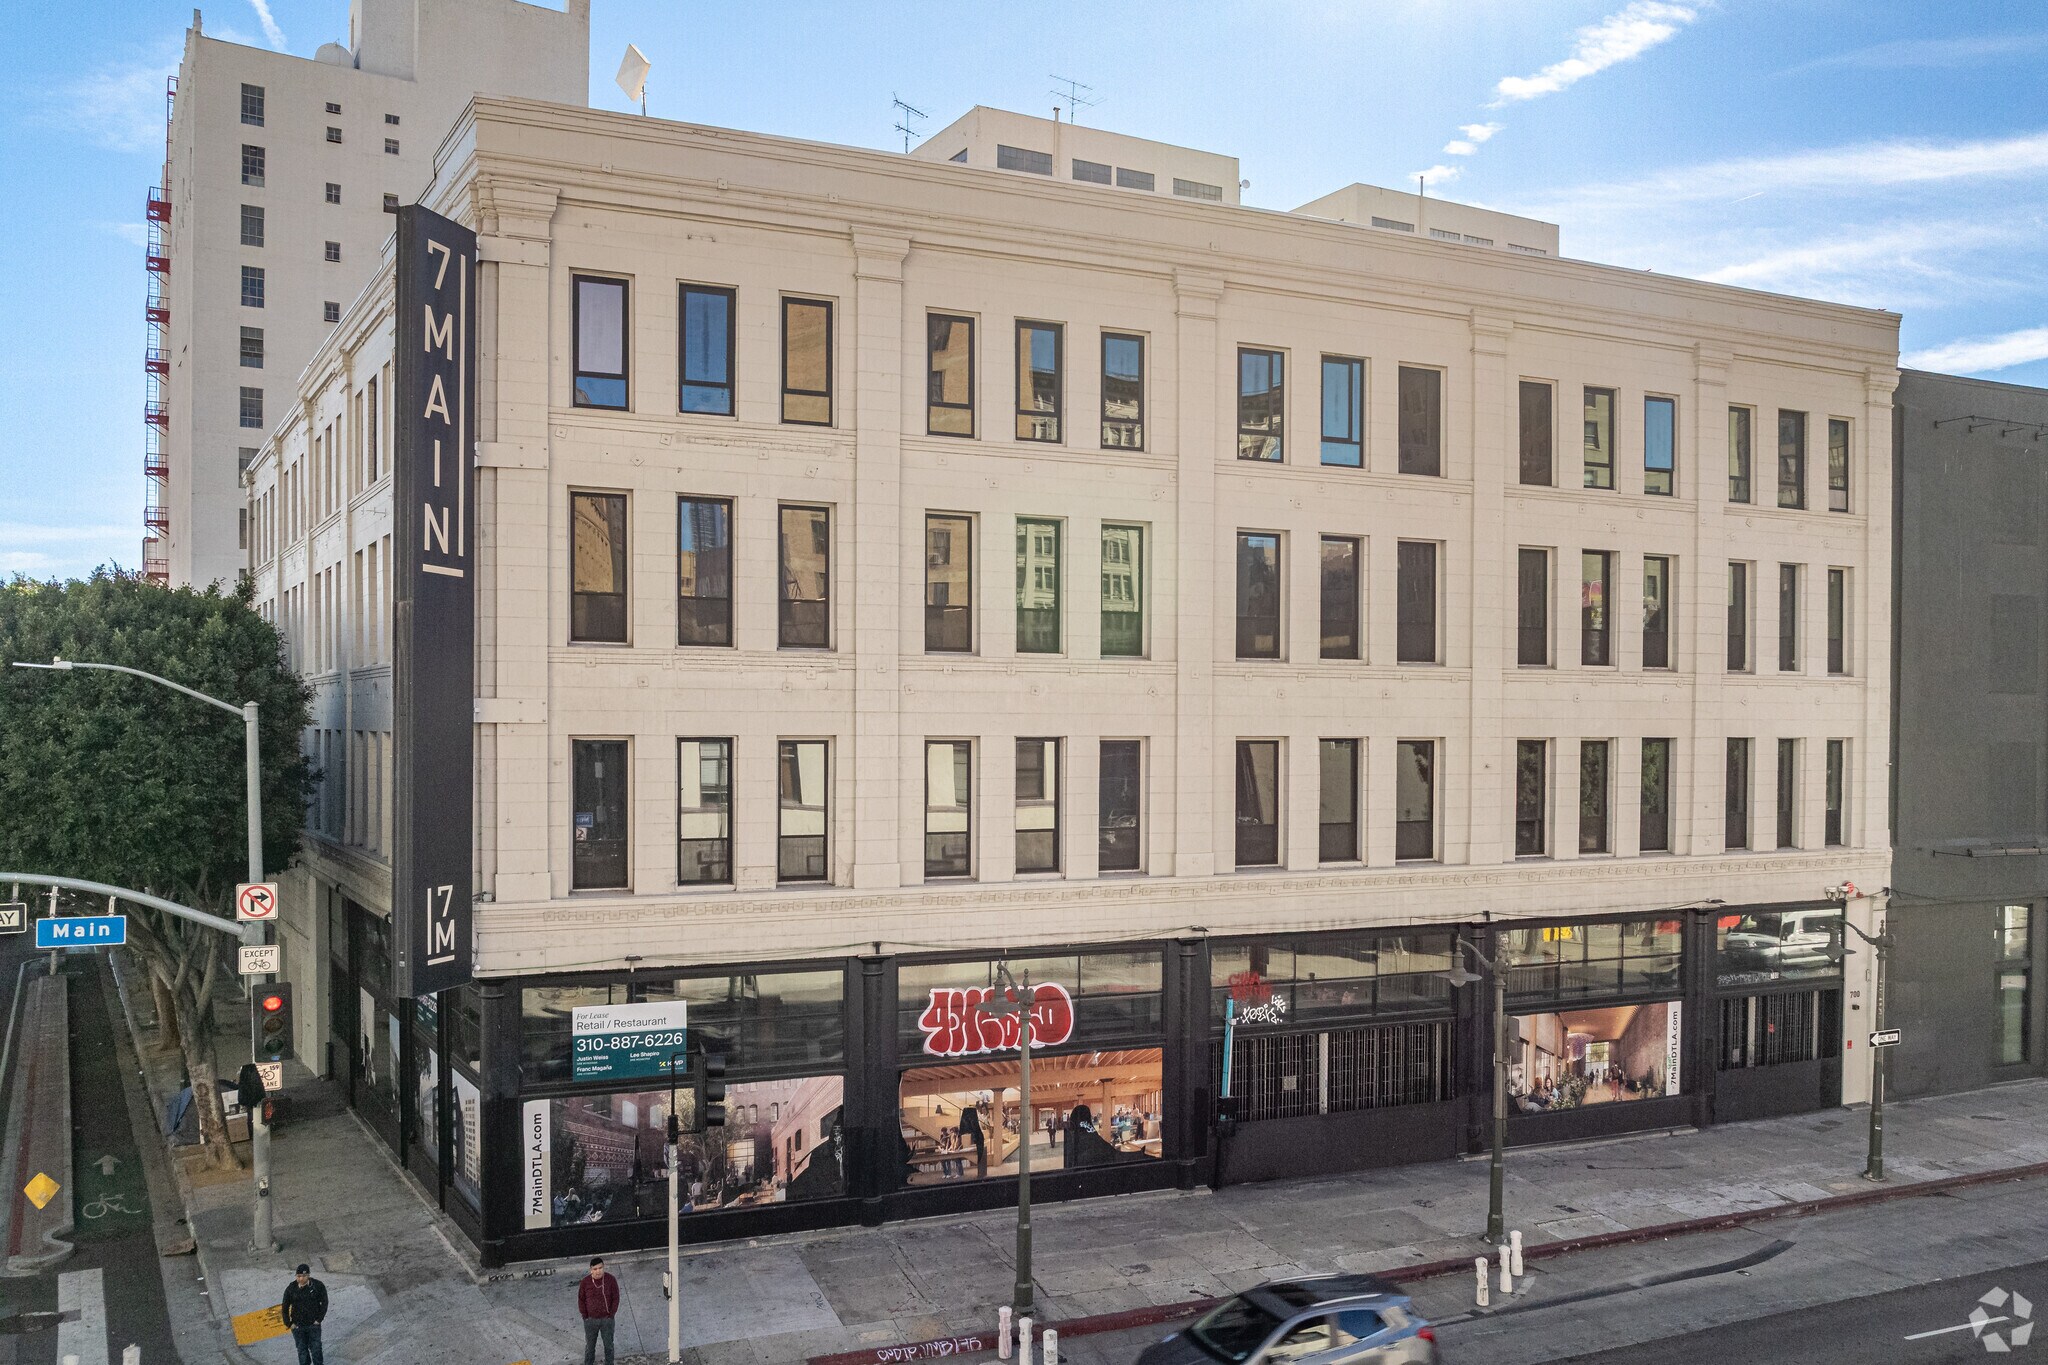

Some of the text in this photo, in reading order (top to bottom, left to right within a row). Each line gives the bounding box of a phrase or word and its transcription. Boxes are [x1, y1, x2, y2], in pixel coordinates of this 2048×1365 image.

[53, 923, 110, 938] Main
[577, 1021, 604, 1030] Retail
[614, 1017, 667, 1028] Restaurant
[577, 1032, 683, 1052] 310-887-6226
[532, 1113, 542, 1215] 7MainDTLA.com
